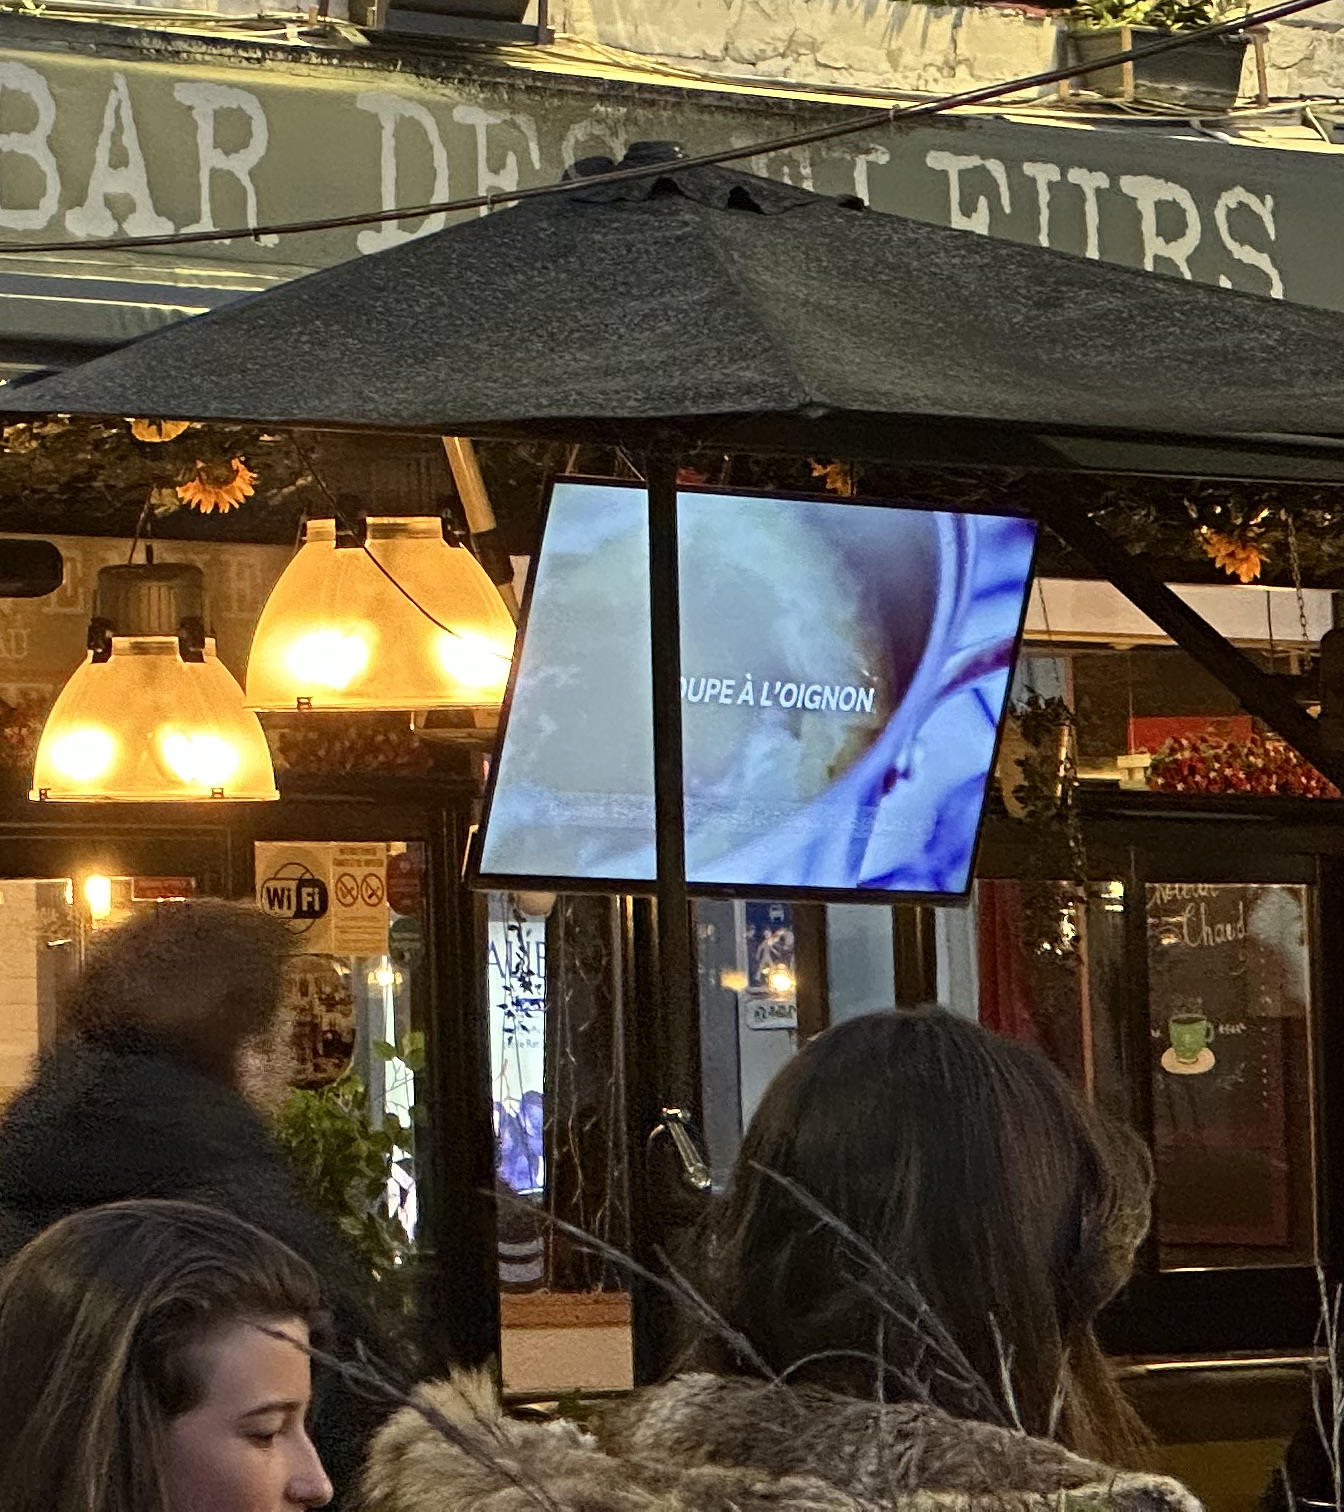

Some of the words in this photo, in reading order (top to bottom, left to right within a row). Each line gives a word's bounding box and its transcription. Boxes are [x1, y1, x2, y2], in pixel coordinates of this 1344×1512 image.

[679, 675, 736, 705] UPE
[736, 673, 755, 707] À
[760, 679, 875, 714] L'OIGNON
